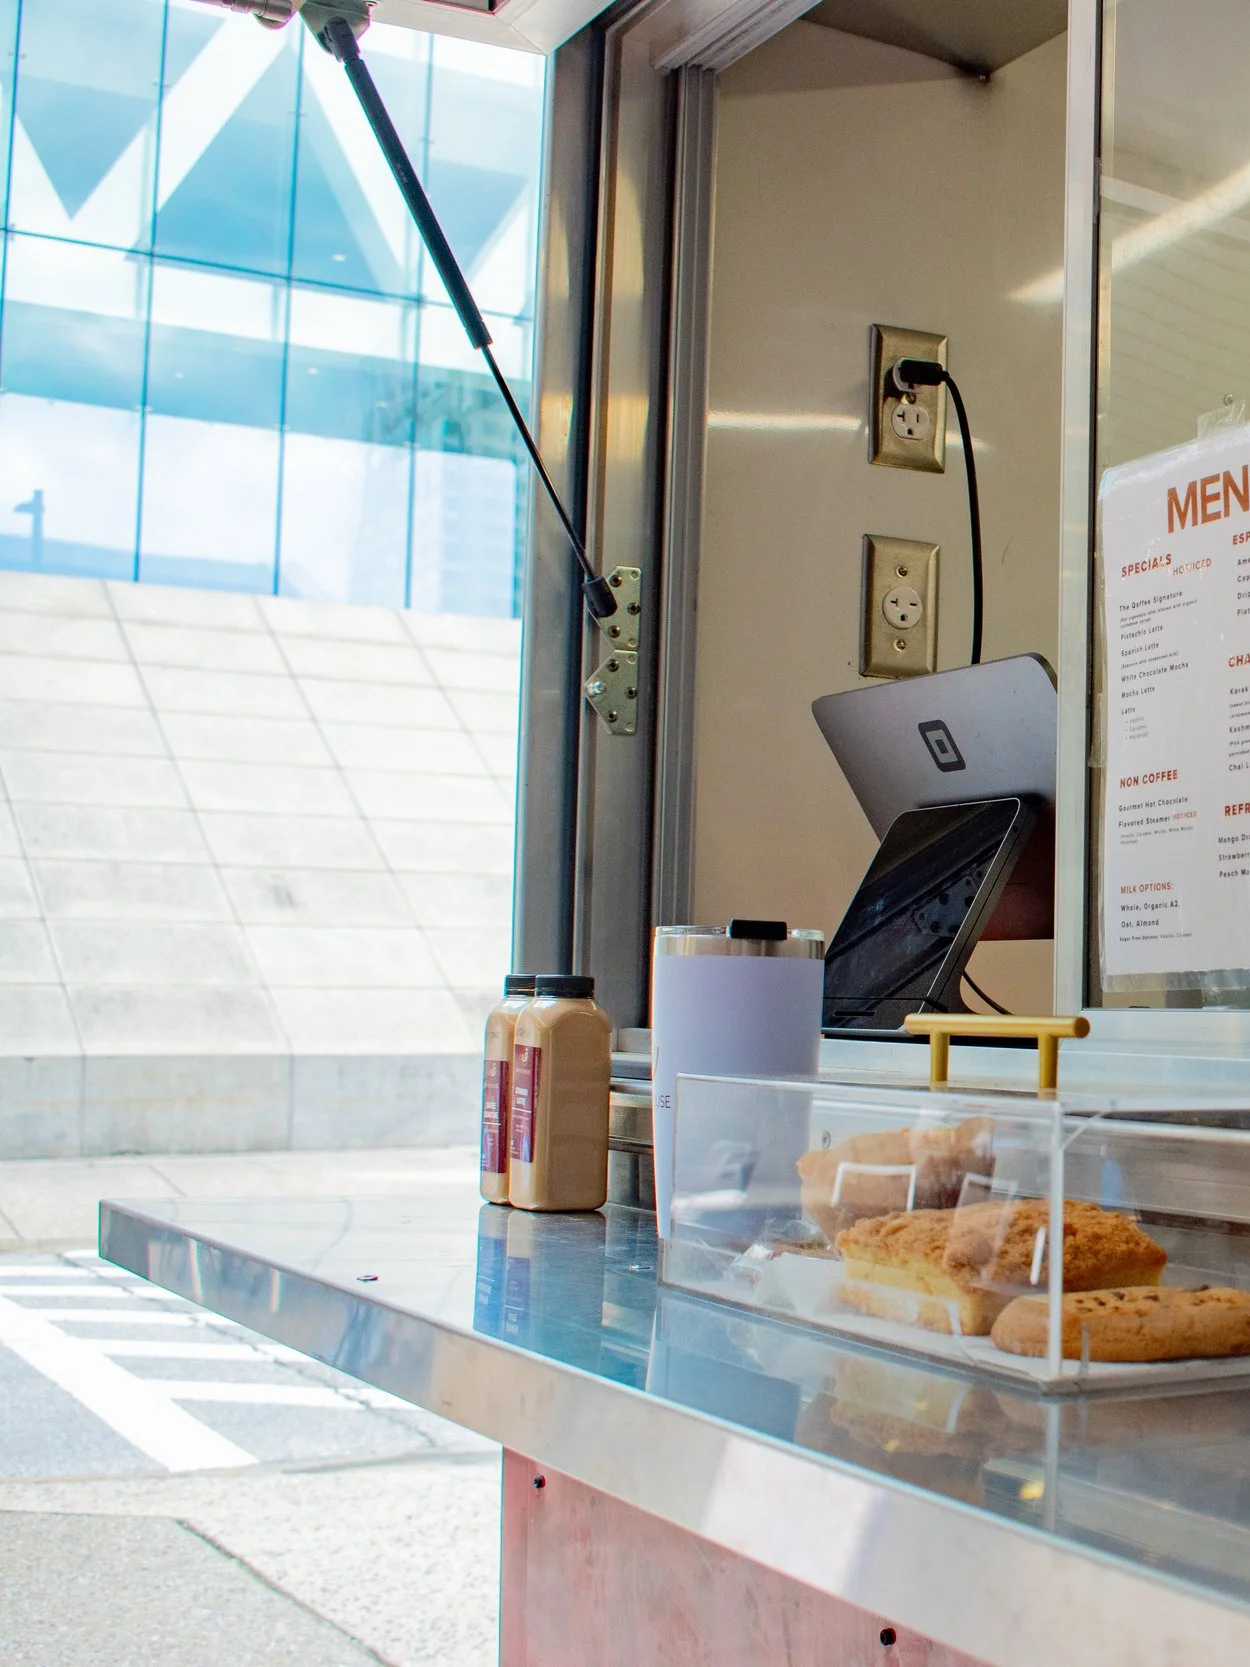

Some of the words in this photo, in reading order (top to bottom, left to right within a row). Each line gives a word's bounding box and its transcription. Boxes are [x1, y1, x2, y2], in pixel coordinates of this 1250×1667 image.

[1122, 554, 1172, 578] SPECIALS
[1131, 598, 1151, 609] Qaffee
[1153, 591, 1183, 604] Signature
[1237, 607, 1250, 616] Flat
[1120, 628, 1147, 640] Pistachio
[1148, 625, 1163, 634] Latte
[1121, 646, 1143, 657] Spanish
[1144, 642, 1159, 651] Latte
[1121, 674, 1137, 682] White
[1138, 666, 1167, 679] Chocolate
[1169, 662, 1189, 671] Mocha
[1121, 689, 1139, 698] Mocha
[1141, 685, 1155, 695] Latte
[1230, 686, 1248, 695] Karak
[1121, 706, 1136, 715] Latte
[1228, 763, 1244, 772] Chai
[1120, 777, 1139, 789] NON
[1142, 769, 1178, 784] COFFEE
[1119, 802, 1143, 812] Gourmet
[1157, 796, 1188, 806] Chocolate
[1118, 818, 1144, 828] Flavored
[1146, 815, 1171, 825] Steamer
[1172, 811, 1197, 820] HOT/ICED
[1218, 836, 1239, 844] Mango
[1219, 870, 1238, 878] Peach
[1120, 884, 1137, 894] MILK
[1139, 881, 1173, 893] OPTIONS:
[1120, 904, 1141, 912] Whole,
[1143, 901, 1168, 911] Organic
[1136, 919, 1159, 927] Almond
